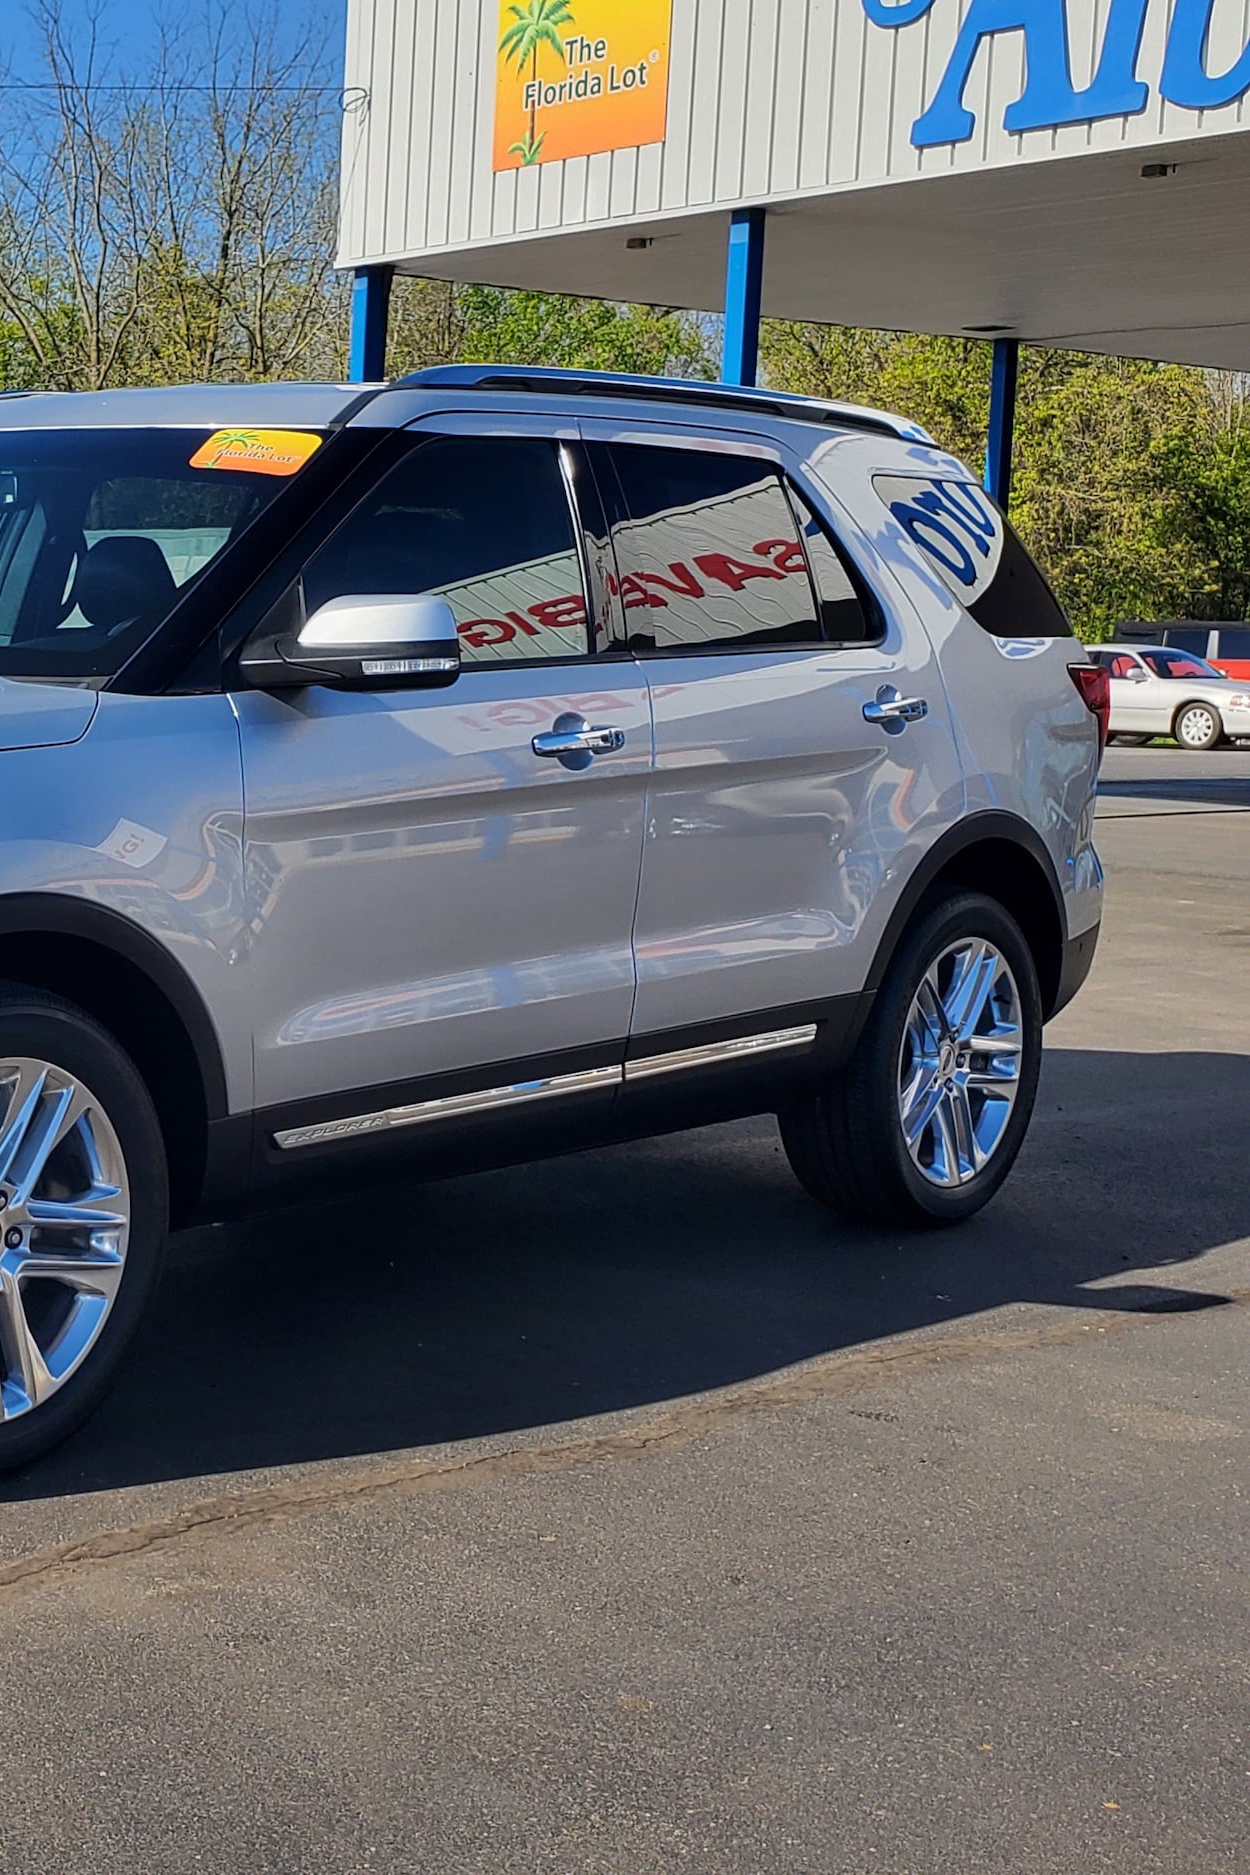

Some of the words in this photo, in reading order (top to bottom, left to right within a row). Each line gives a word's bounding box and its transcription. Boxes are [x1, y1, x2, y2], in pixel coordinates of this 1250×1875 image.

[565, 36, 606, 65] The
[524, 70, 601, 109] Florida
[609, 62, 647, 91] Lot
[217, 449, 265, 460] Florida
[250, 442, 274, 451] The
[284, 1116, 384, 1144] EXPLORER
